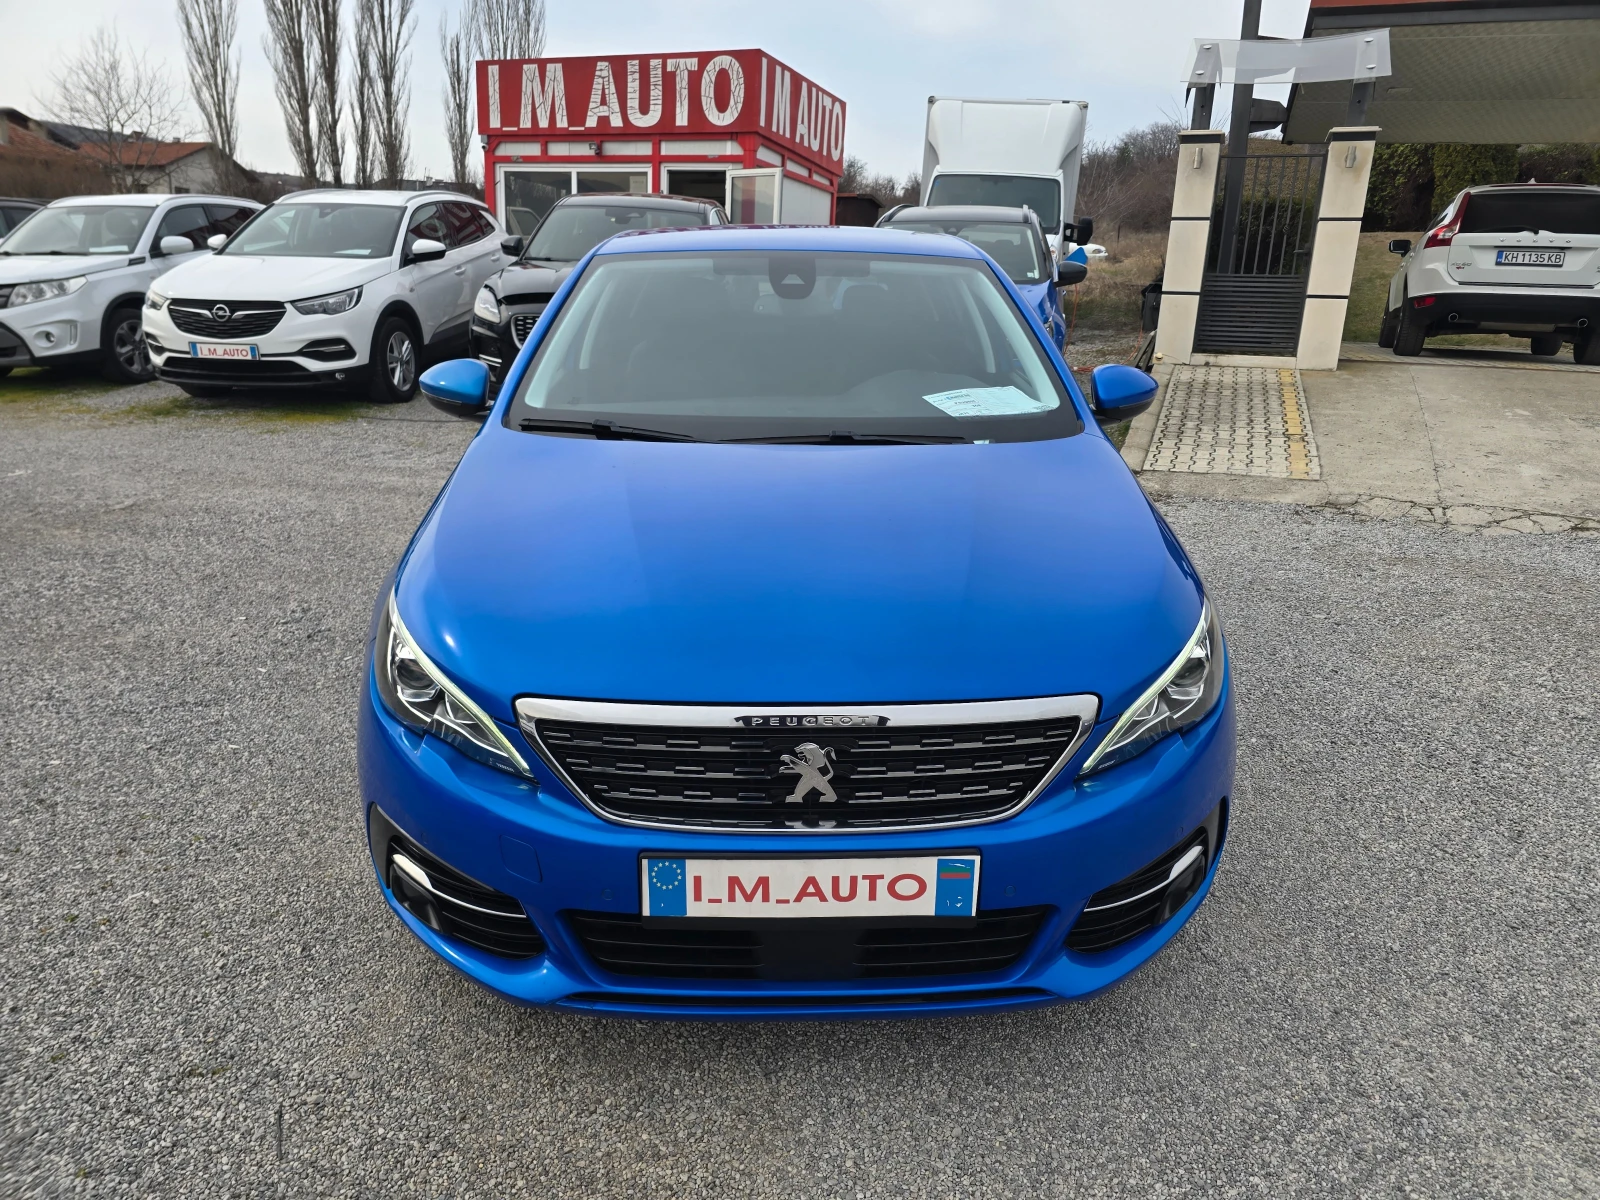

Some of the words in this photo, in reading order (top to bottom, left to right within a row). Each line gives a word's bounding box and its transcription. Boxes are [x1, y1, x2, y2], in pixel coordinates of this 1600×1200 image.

[760, 57, 767, 127] I
[772, 65, 791, 139] M
[795, 81, 843, 162] AUTO
[1504, 252, 1519, 263] KH
[1521, 253, 1546, 263] 1135
[1547, 253, 1563, 264] KB
[751, 716, 870, 727] PEUGEOT
